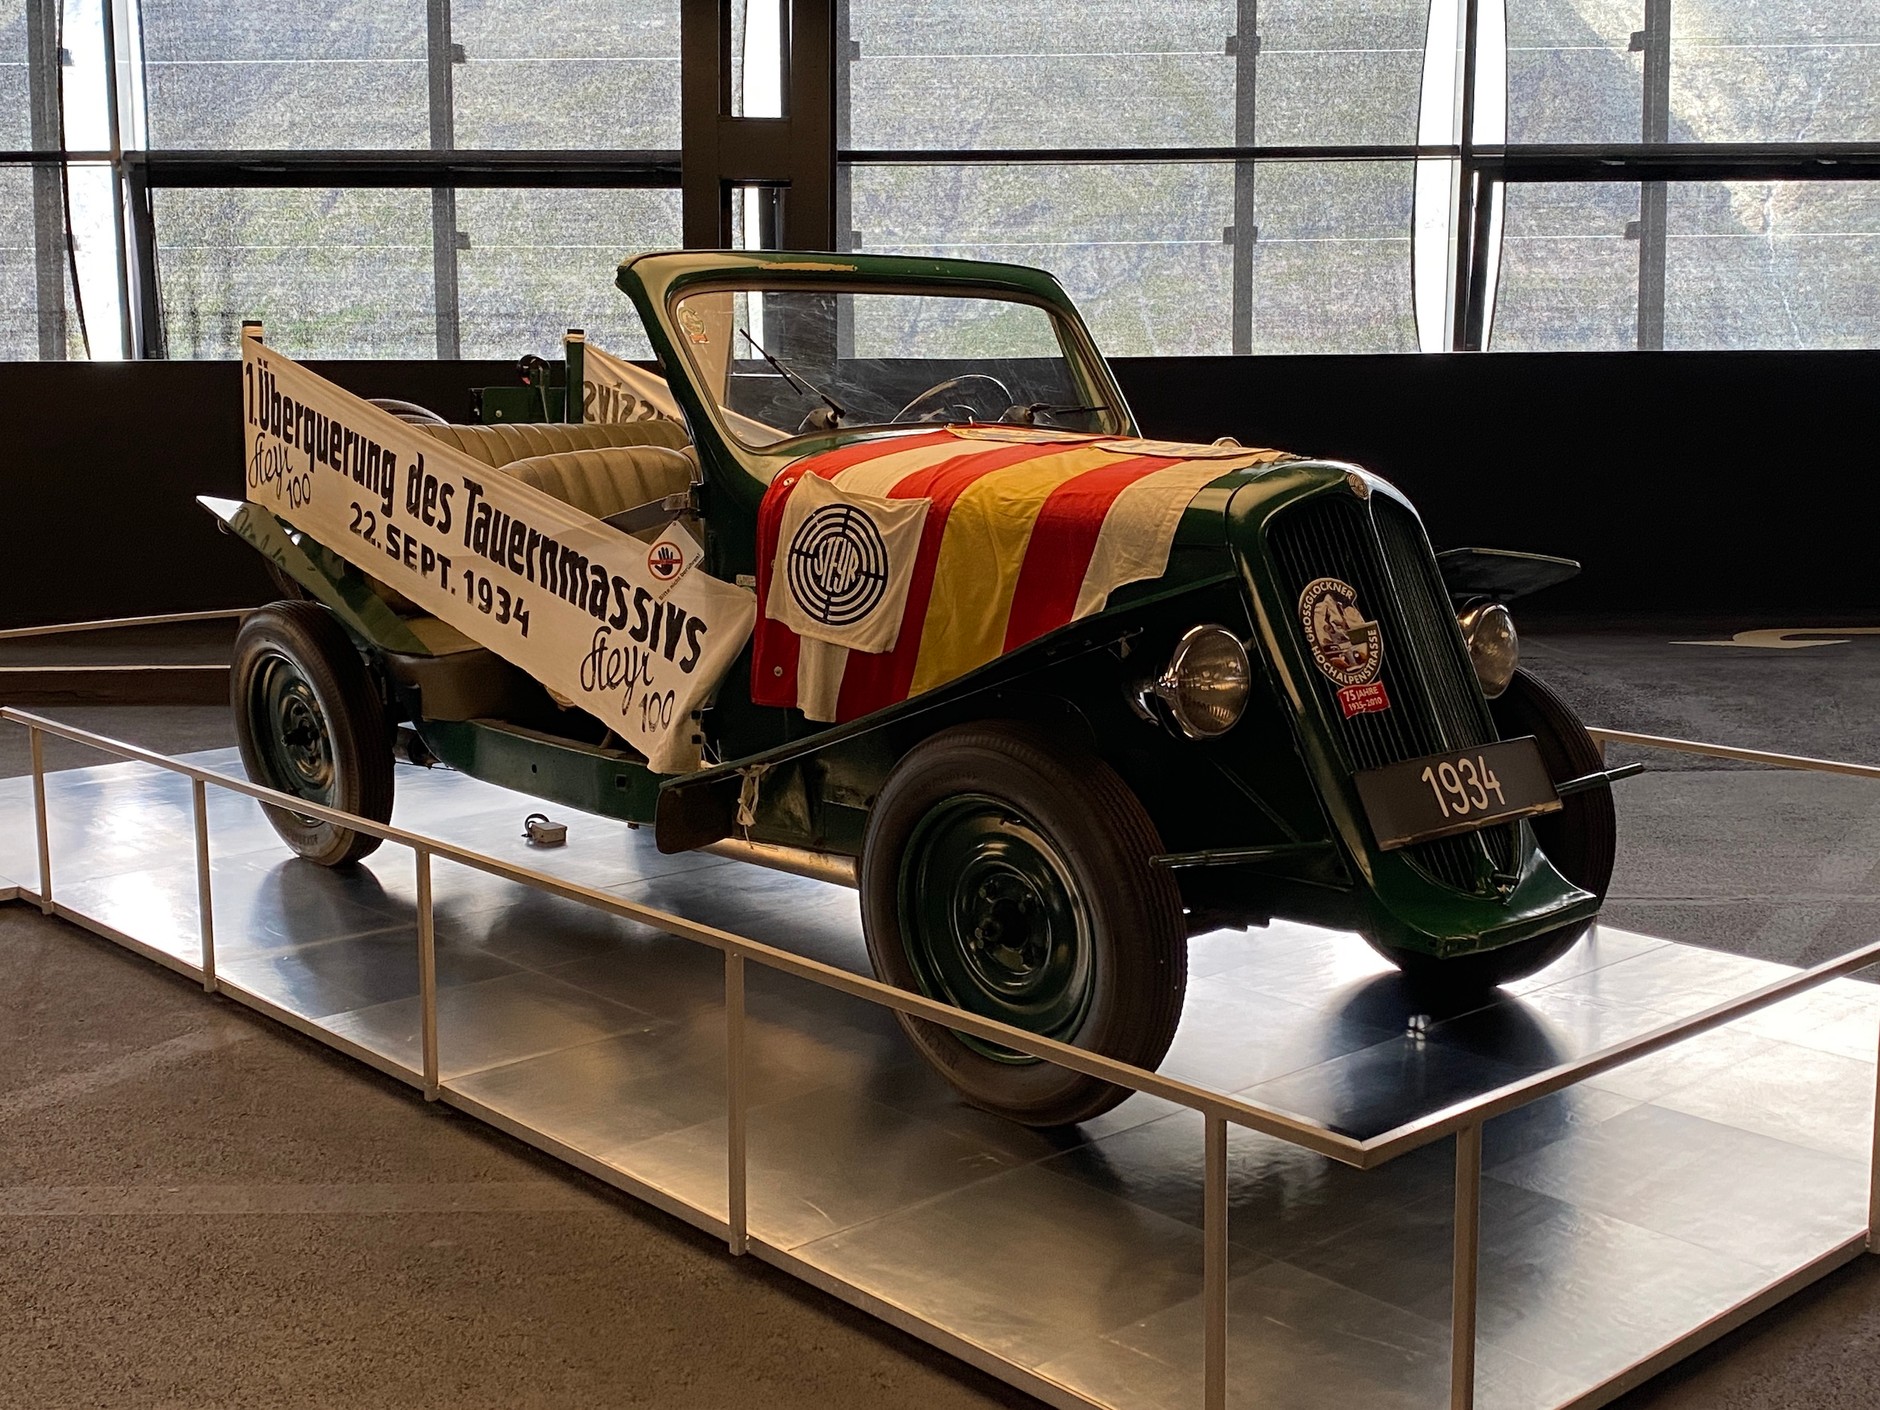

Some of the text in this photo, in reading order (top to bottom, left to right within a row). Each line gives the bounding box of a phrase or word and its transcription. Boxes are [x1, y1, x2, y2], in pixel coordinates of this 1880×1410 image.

[286, 472, 312, 510] 100
[406, 452, 455, 534] des
[462, 476, 708, 674] Tauernmassivs
[814, 536, 860, 594] STEYR
[463, 569, 531, 638] 1934
[1302, 580, 1354, 643] GROSSGLOCKNER
[1312, 628, 1379, 685] HOCHALPENSTRASSE
[638, 689, 675, 733] 100
[1343, 686, 1379, 702] 75 JAHRE
[1421, 755, 1506, 818] 1934
